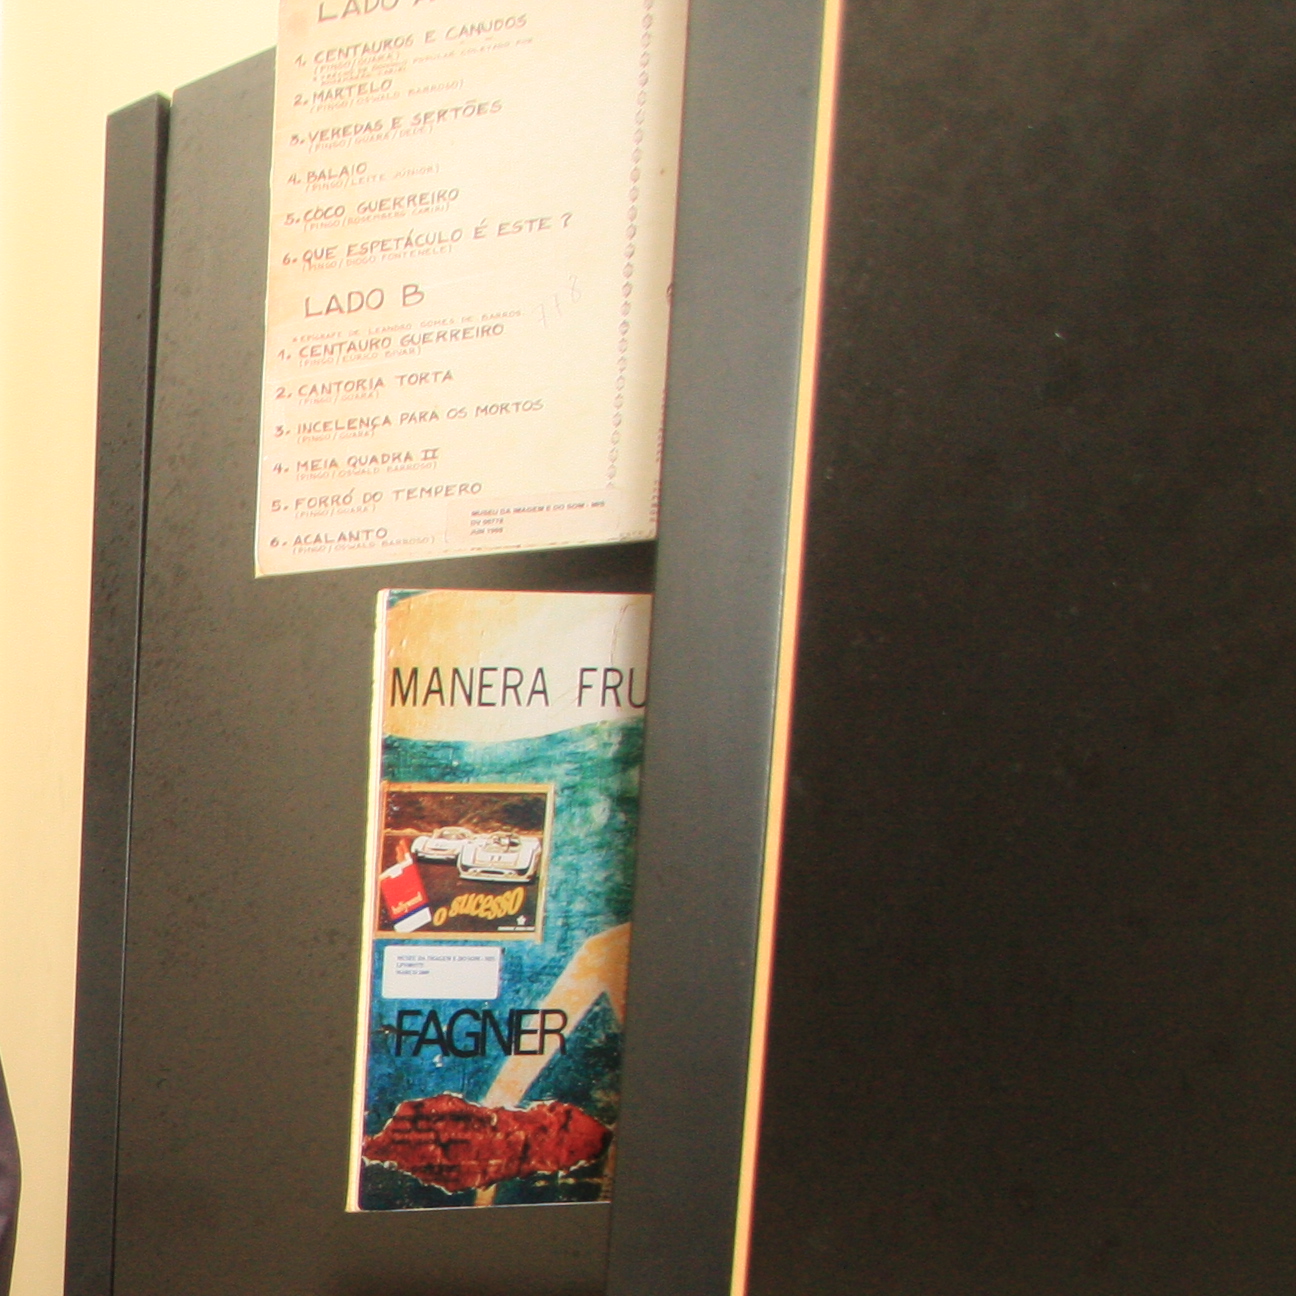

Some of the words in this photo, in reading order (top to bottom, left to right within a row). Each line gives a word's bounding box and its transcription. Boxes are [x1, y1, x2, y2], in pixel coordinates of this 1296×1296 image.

[294, 53, 307, 68] 1.
[313, 33, 414, 64] CENTAUROS
[424, 29, 437, 44] E
[445, 13, 527, 41] CANUDOS
[293, 94, 309, 107] 2.
[313, 79, 393, 104] MARTELO
[289, 134, 305, 146] 3.
[308, 119, 384, 142] VEREDAS
[391, 116, 403, 130] E
[410, 98, 504, 127] SERTÕES
[287, 173, 301, 186] 4.
[307, 161, 368, 183] BALAIO
[284, 213, 300, 226] 5.
[357, 188, 460, 214] GUERREIRO
[282, 252, 297, 266] 6.
[302, 245, 338, 268] QUE
[346, 228, 463, 257] ESPETÁCULO
[473, 217, 488, 240] É
[497, 216, 553, 237] ESTE
[304, 287, 385, 319] LADO
[402, 283, 426, 307] B
[277, 348, 292, 361] 1.
[299, 336, 392, 358] CENTAURO
[400, 323, 504, 347] GUERREIRO
[275, 386, 292, 399] 2.
[298, 376, 385, 397] CANTORIA
[395, 369, 455, 387] TORTA
[274, 424, 291, 438] 3.
[297, 414, 392, 434] INCELENÇA
[399, 410, 440, 425] PARA
[446, 407, 468, 420] OS
[474, 398, 544, 417] MORTOS
[272, 463, 289, 474] 4.
[296, 458, 340, 473] MEIA
[346, 451, 414, 468] QUADRA
[420, 447, 440, 461] II
[271, 499, 289, 513] 5.
[294, 487, 356, 511] FORRÓ
[362, 491, 384, 503] DO
[391, 482, 482, 502] TEMPERO
[270, 536, 288, 548] 6.
[292, 527, 388, 546] ACALANTO
[389, 666, 550, 708] MANERA
[576, 666, 648, 709] FRU
[393, 1008, 569, 1058] FAGNER
